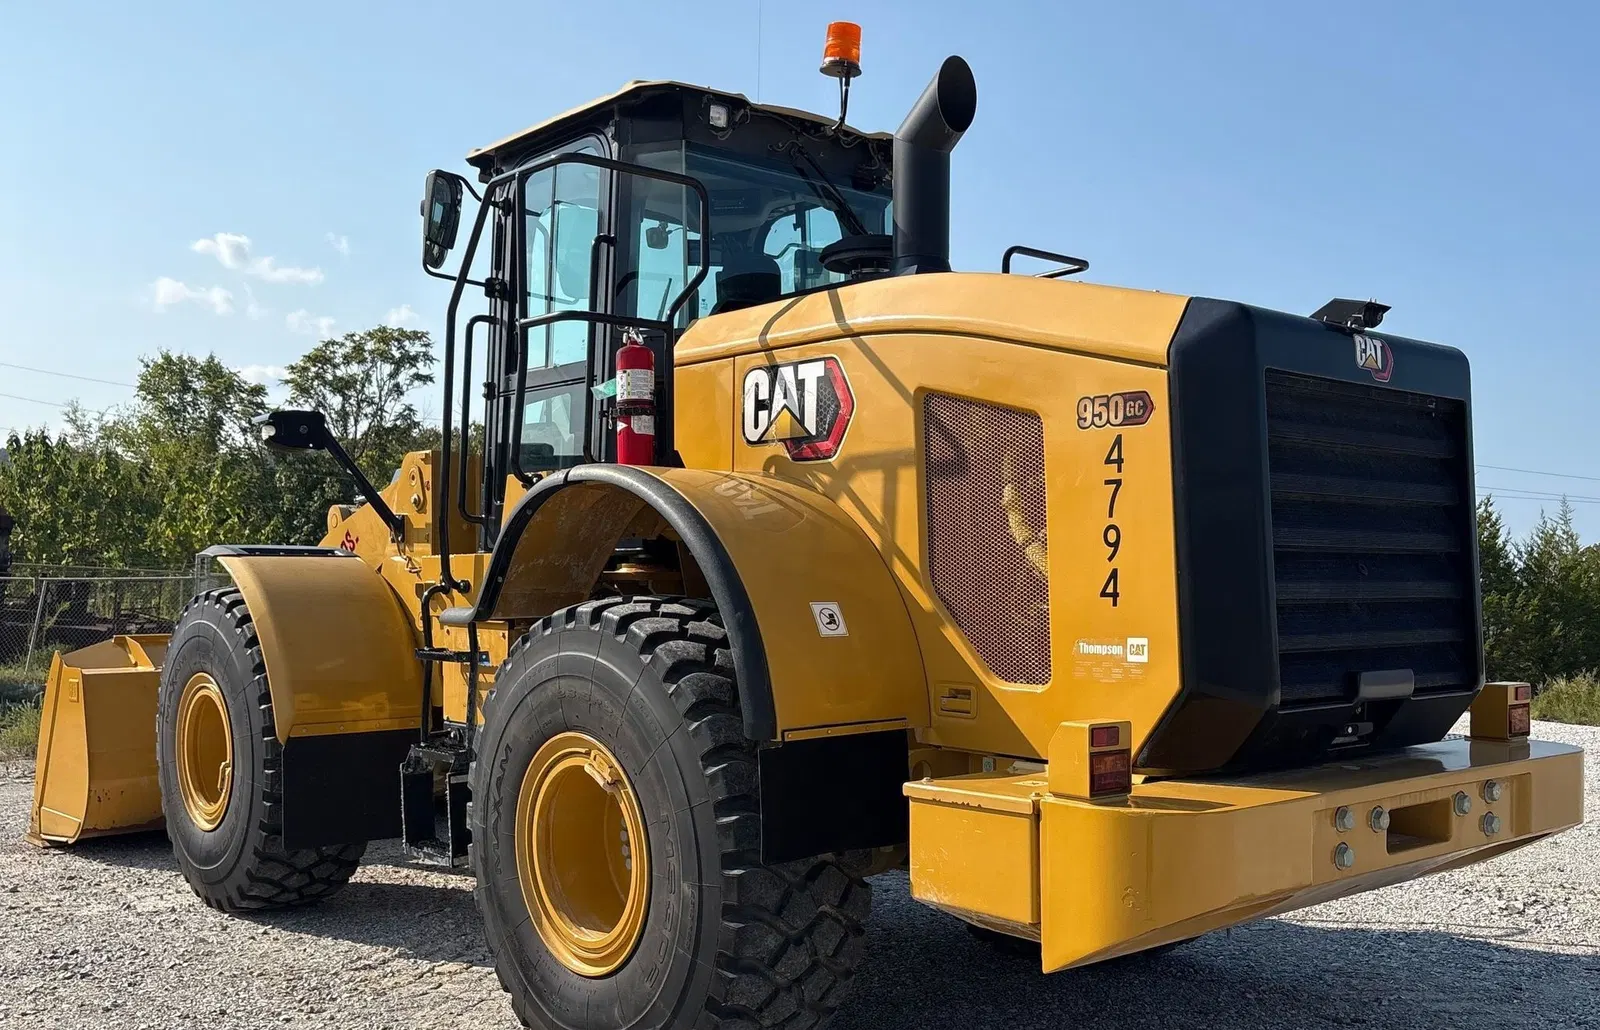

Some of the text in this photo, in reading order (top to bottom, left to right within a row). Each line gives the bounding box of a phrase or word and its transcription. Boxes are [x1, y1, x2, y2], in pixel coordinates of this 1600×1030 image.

[1354, 334, 1382, 370] CAT
[743, 360, 825, 442] CAT
[1078, 395, 1144, 428] 950 GC
[1099, 433, 1124, 607] 4794
[1079, 642, 1146, 656] Thompson CAT
[491, 743, 513, 875] MAXAM
